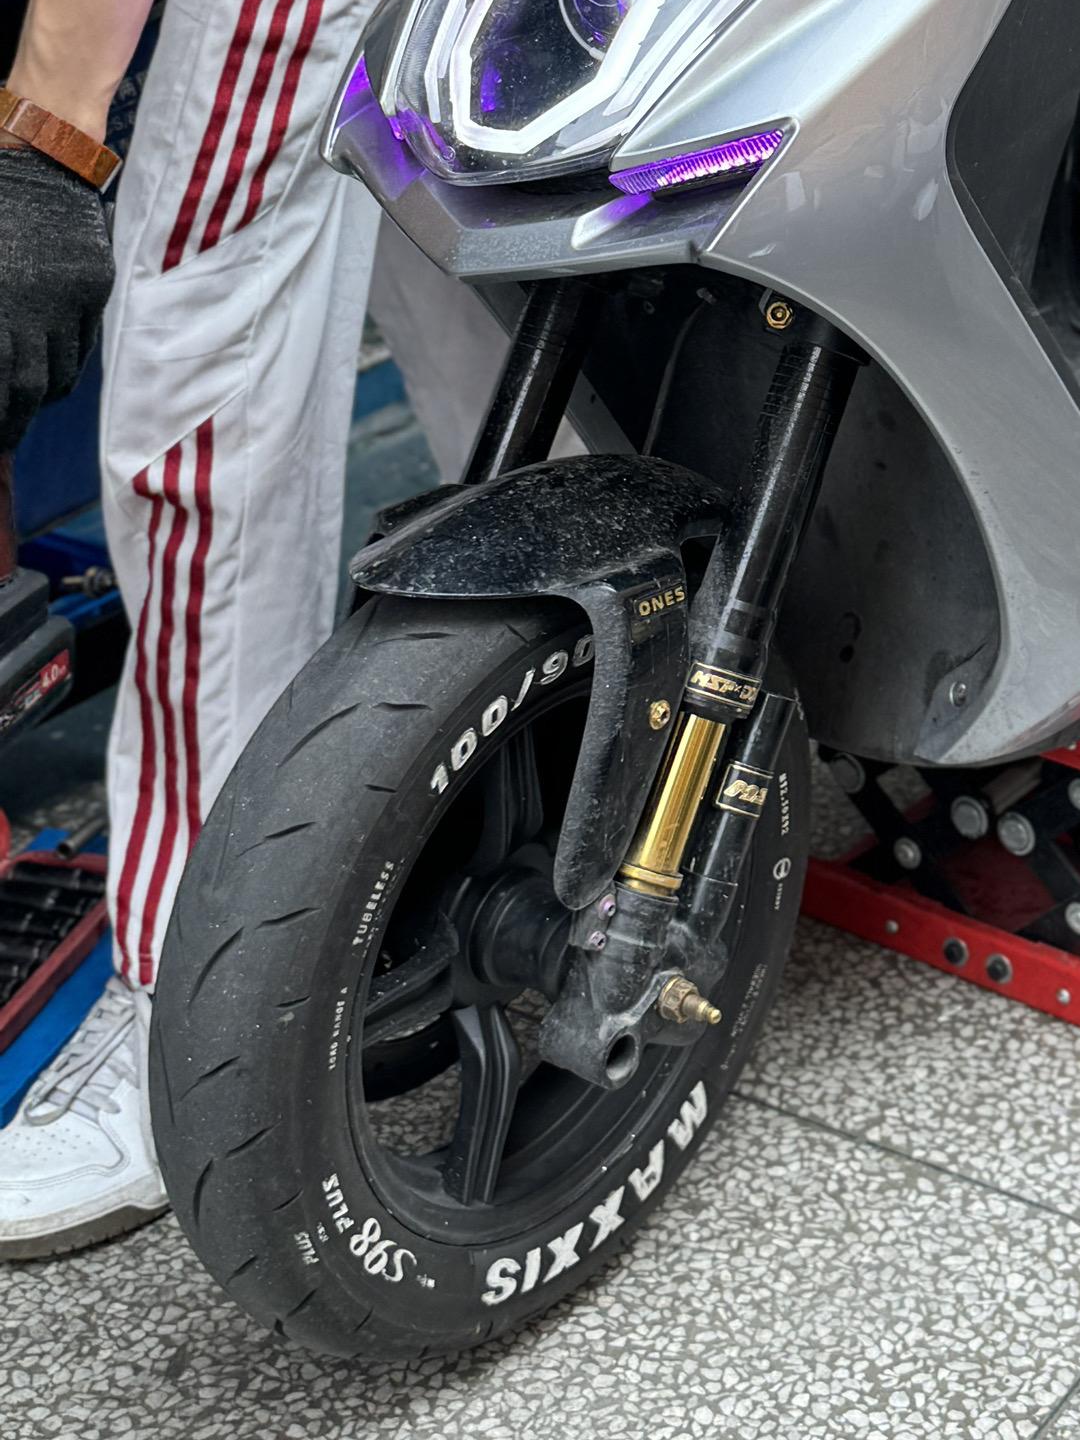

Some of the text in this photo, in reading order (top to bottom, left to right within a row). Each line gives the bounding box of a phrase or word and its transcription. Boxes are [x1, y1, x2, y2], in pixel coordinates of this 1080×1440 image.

[638, 586, 686, 617] ONES
[428, 634, 595, 795] 100/90
[352, 860, 395, 946] TUBELESS
[322, 1173, 418, 1282] S98 PLUS
[481, 1080, 708, 1306] MAXXIS
[294, 1231, 320, 1265] PLUS
